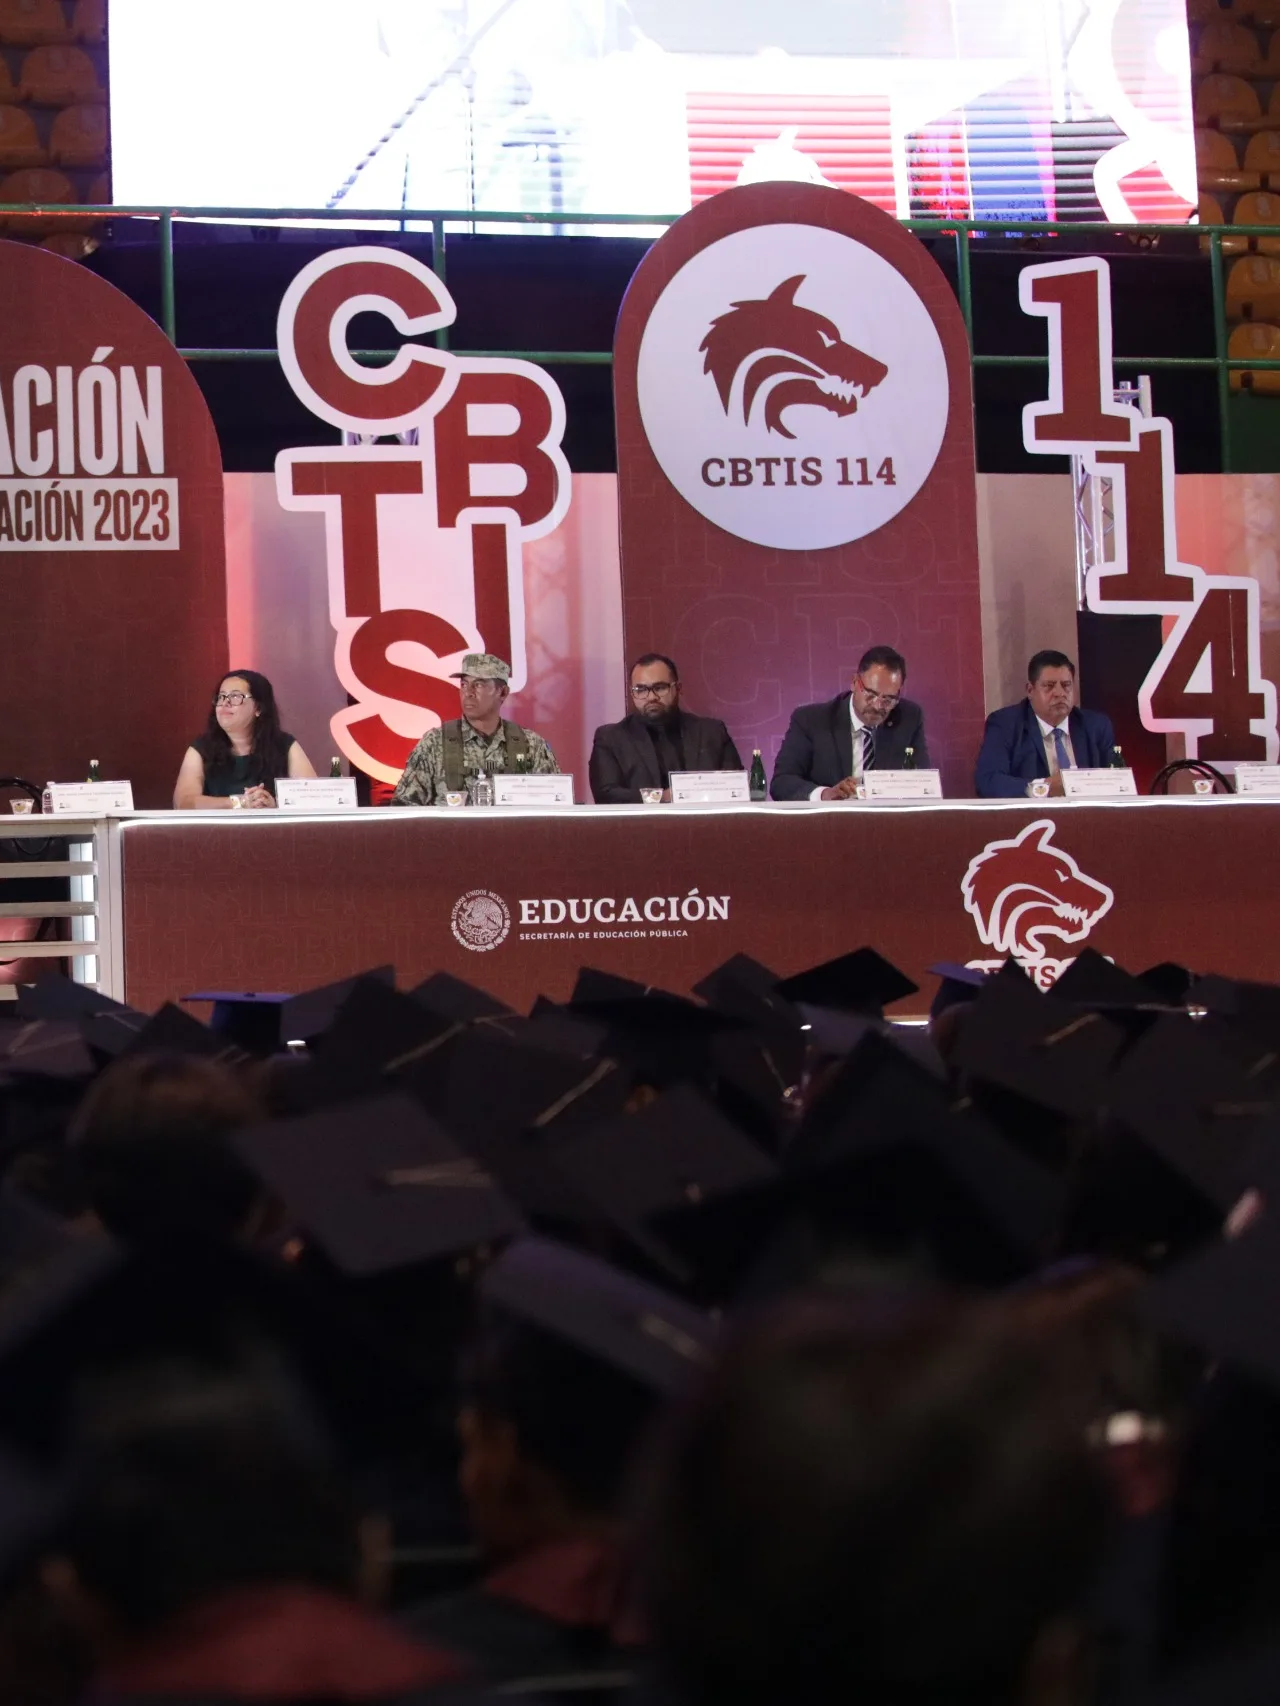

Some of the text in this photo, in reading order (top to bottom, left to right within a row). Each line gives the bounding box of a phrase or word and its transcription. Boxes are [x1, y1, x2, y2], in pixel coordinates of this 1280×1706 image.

[701, 456, 896, 487] CBTIS 114
[93, 488, 170, 542] 2023
[519, 887, 731, 924] EDUCACIÓN
[519, 928, 688, 941] SECRETARÍA DE EDUCACIÓN PÚBLICA
